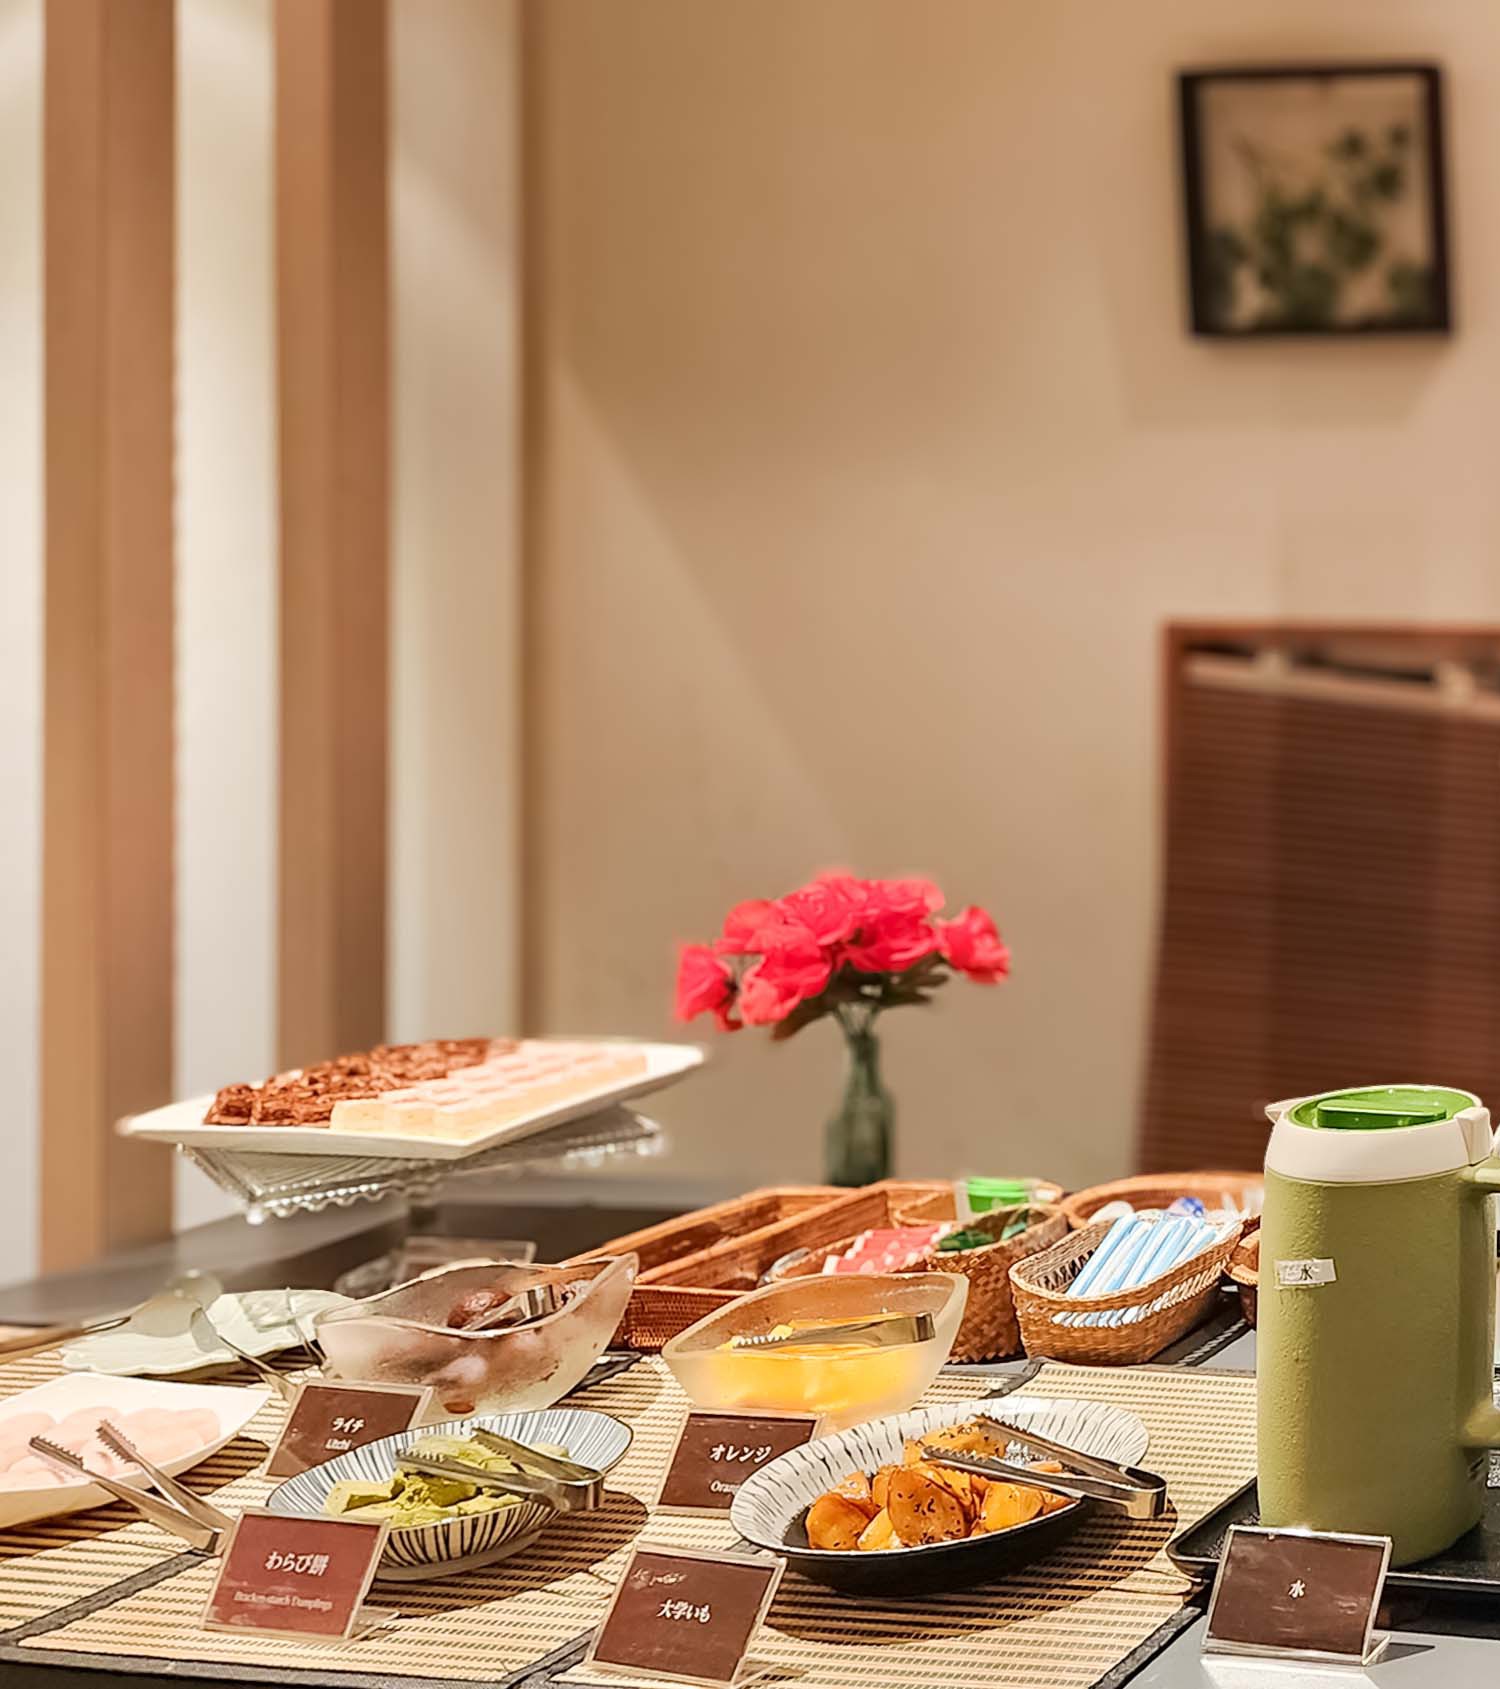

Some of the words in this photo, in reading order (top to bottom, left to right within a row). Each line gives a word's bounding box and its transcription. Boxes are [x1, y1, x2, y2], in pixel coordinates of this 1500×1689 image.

[332, 1417, 364, 1433] ライチ
[709, 1443, 772, 1463] オレンジ
[710, 1480, 741, 1493] Oran
[265, 1551, 330, 1577] わらび餅
[1288, 1579, 1306, 1599] 水
[656, 1599, 711, 1623] 大学いも
